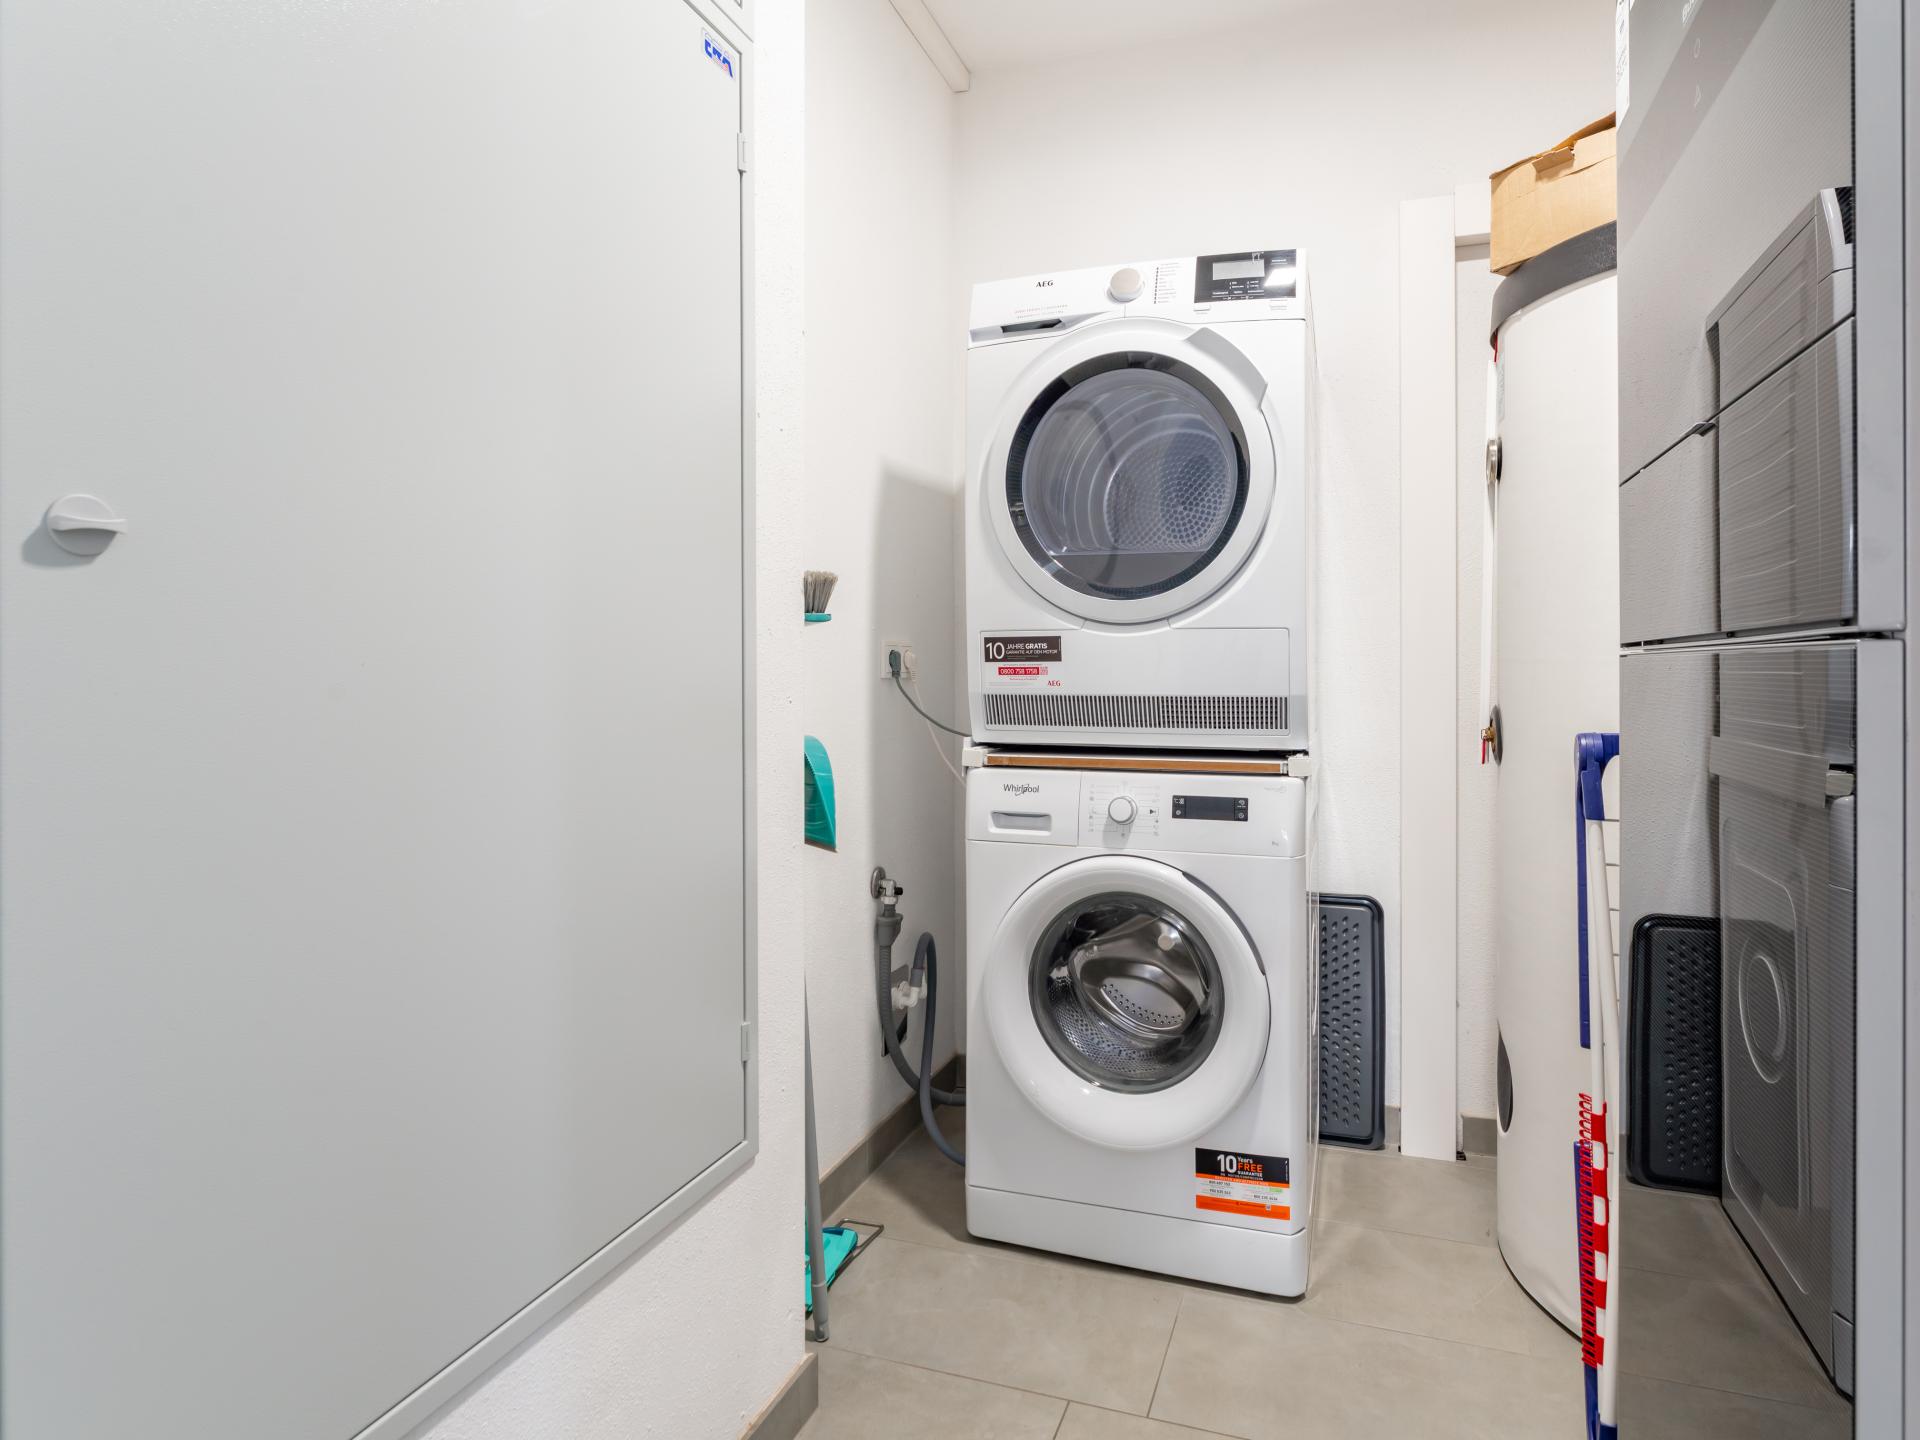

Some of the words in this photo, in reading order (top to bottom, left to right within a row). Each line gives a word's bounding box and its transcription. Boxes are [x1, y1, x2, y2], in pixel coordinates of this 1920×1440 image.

[1036, 279, 1053, 287] AEG
[985, 642, 1005, 659] 10
[1003, 784, 1040, 795] Whirlpool
[1217, 1154, 1237, 1173] 10
[1238, 1162, 1263, 1172] FREE
